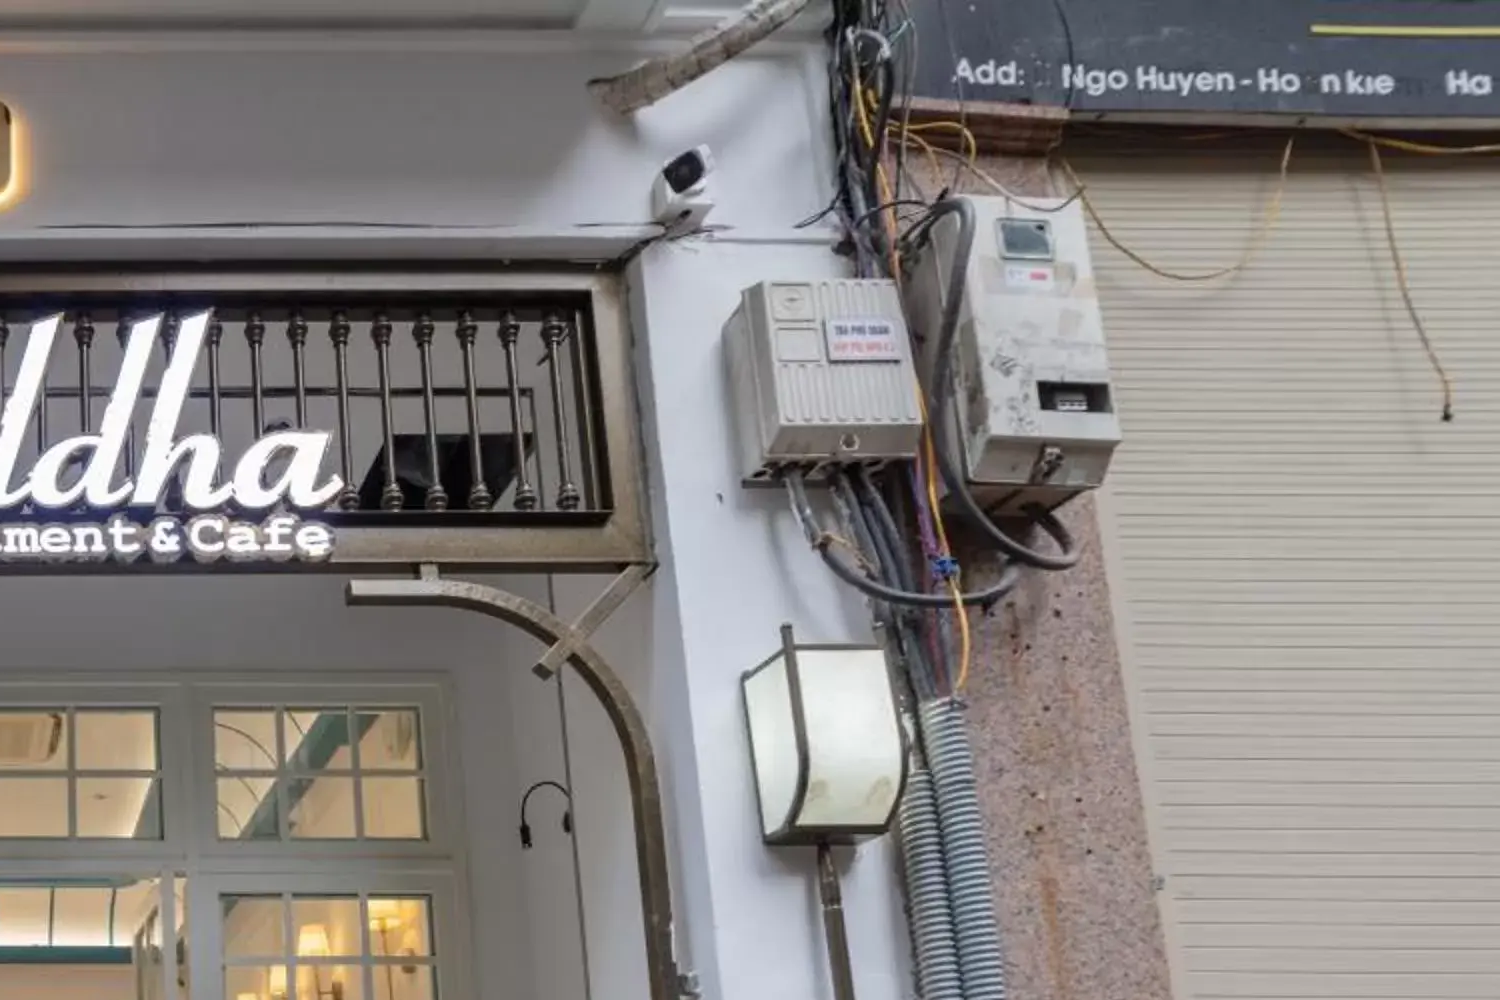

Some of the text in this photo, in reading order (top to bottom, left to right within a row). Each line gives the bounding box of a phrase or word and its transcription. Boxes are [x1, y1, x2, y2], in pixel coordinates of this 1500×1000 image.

[956, 58, 1025, 86] Add:
[1062, 64, 1129, 96] Ngo
[1137, 66, 1235, 97] Huyen
[151, 520, 181, 555] &
[190, 518, 333, 557] Cafe
